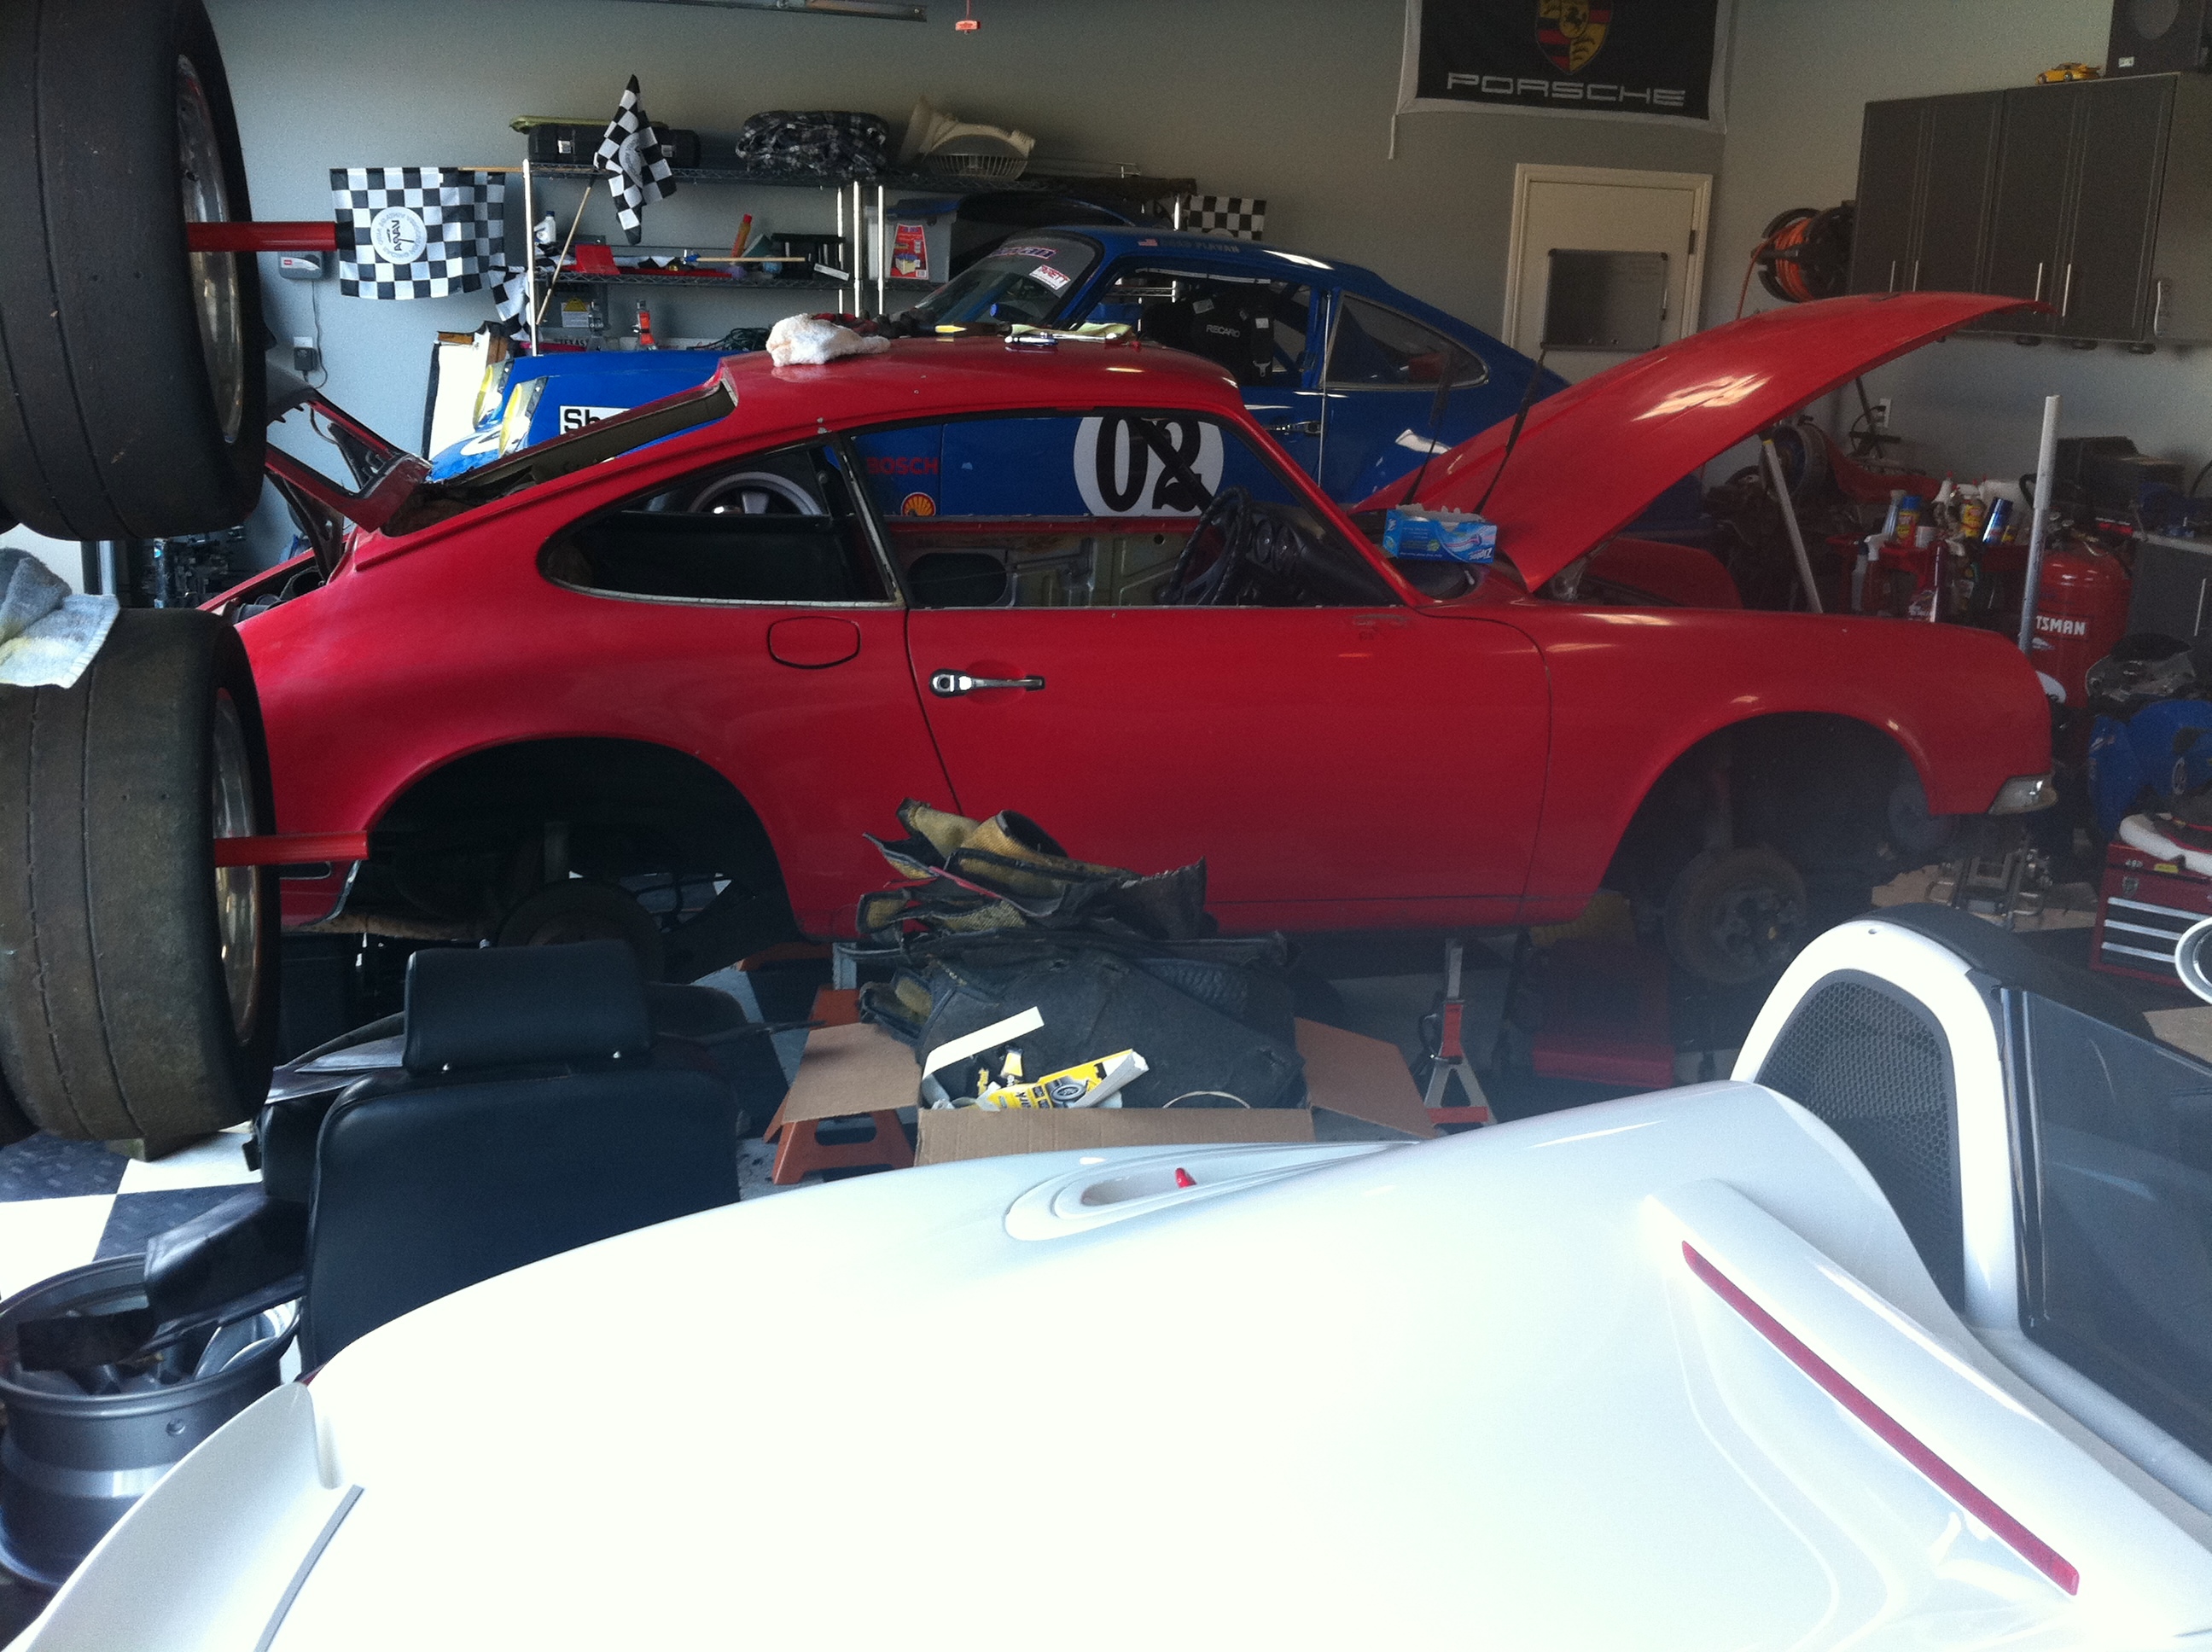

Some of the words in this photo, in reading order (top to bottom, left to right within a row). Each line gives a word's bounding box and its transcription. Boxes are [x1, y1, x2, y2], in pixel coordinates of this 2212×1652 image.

[1447, 72, 1685, 107] PORSCHE
[1206, 324, 1240, 338] RECARO
[866, 457, 939, 475] BOSCH
